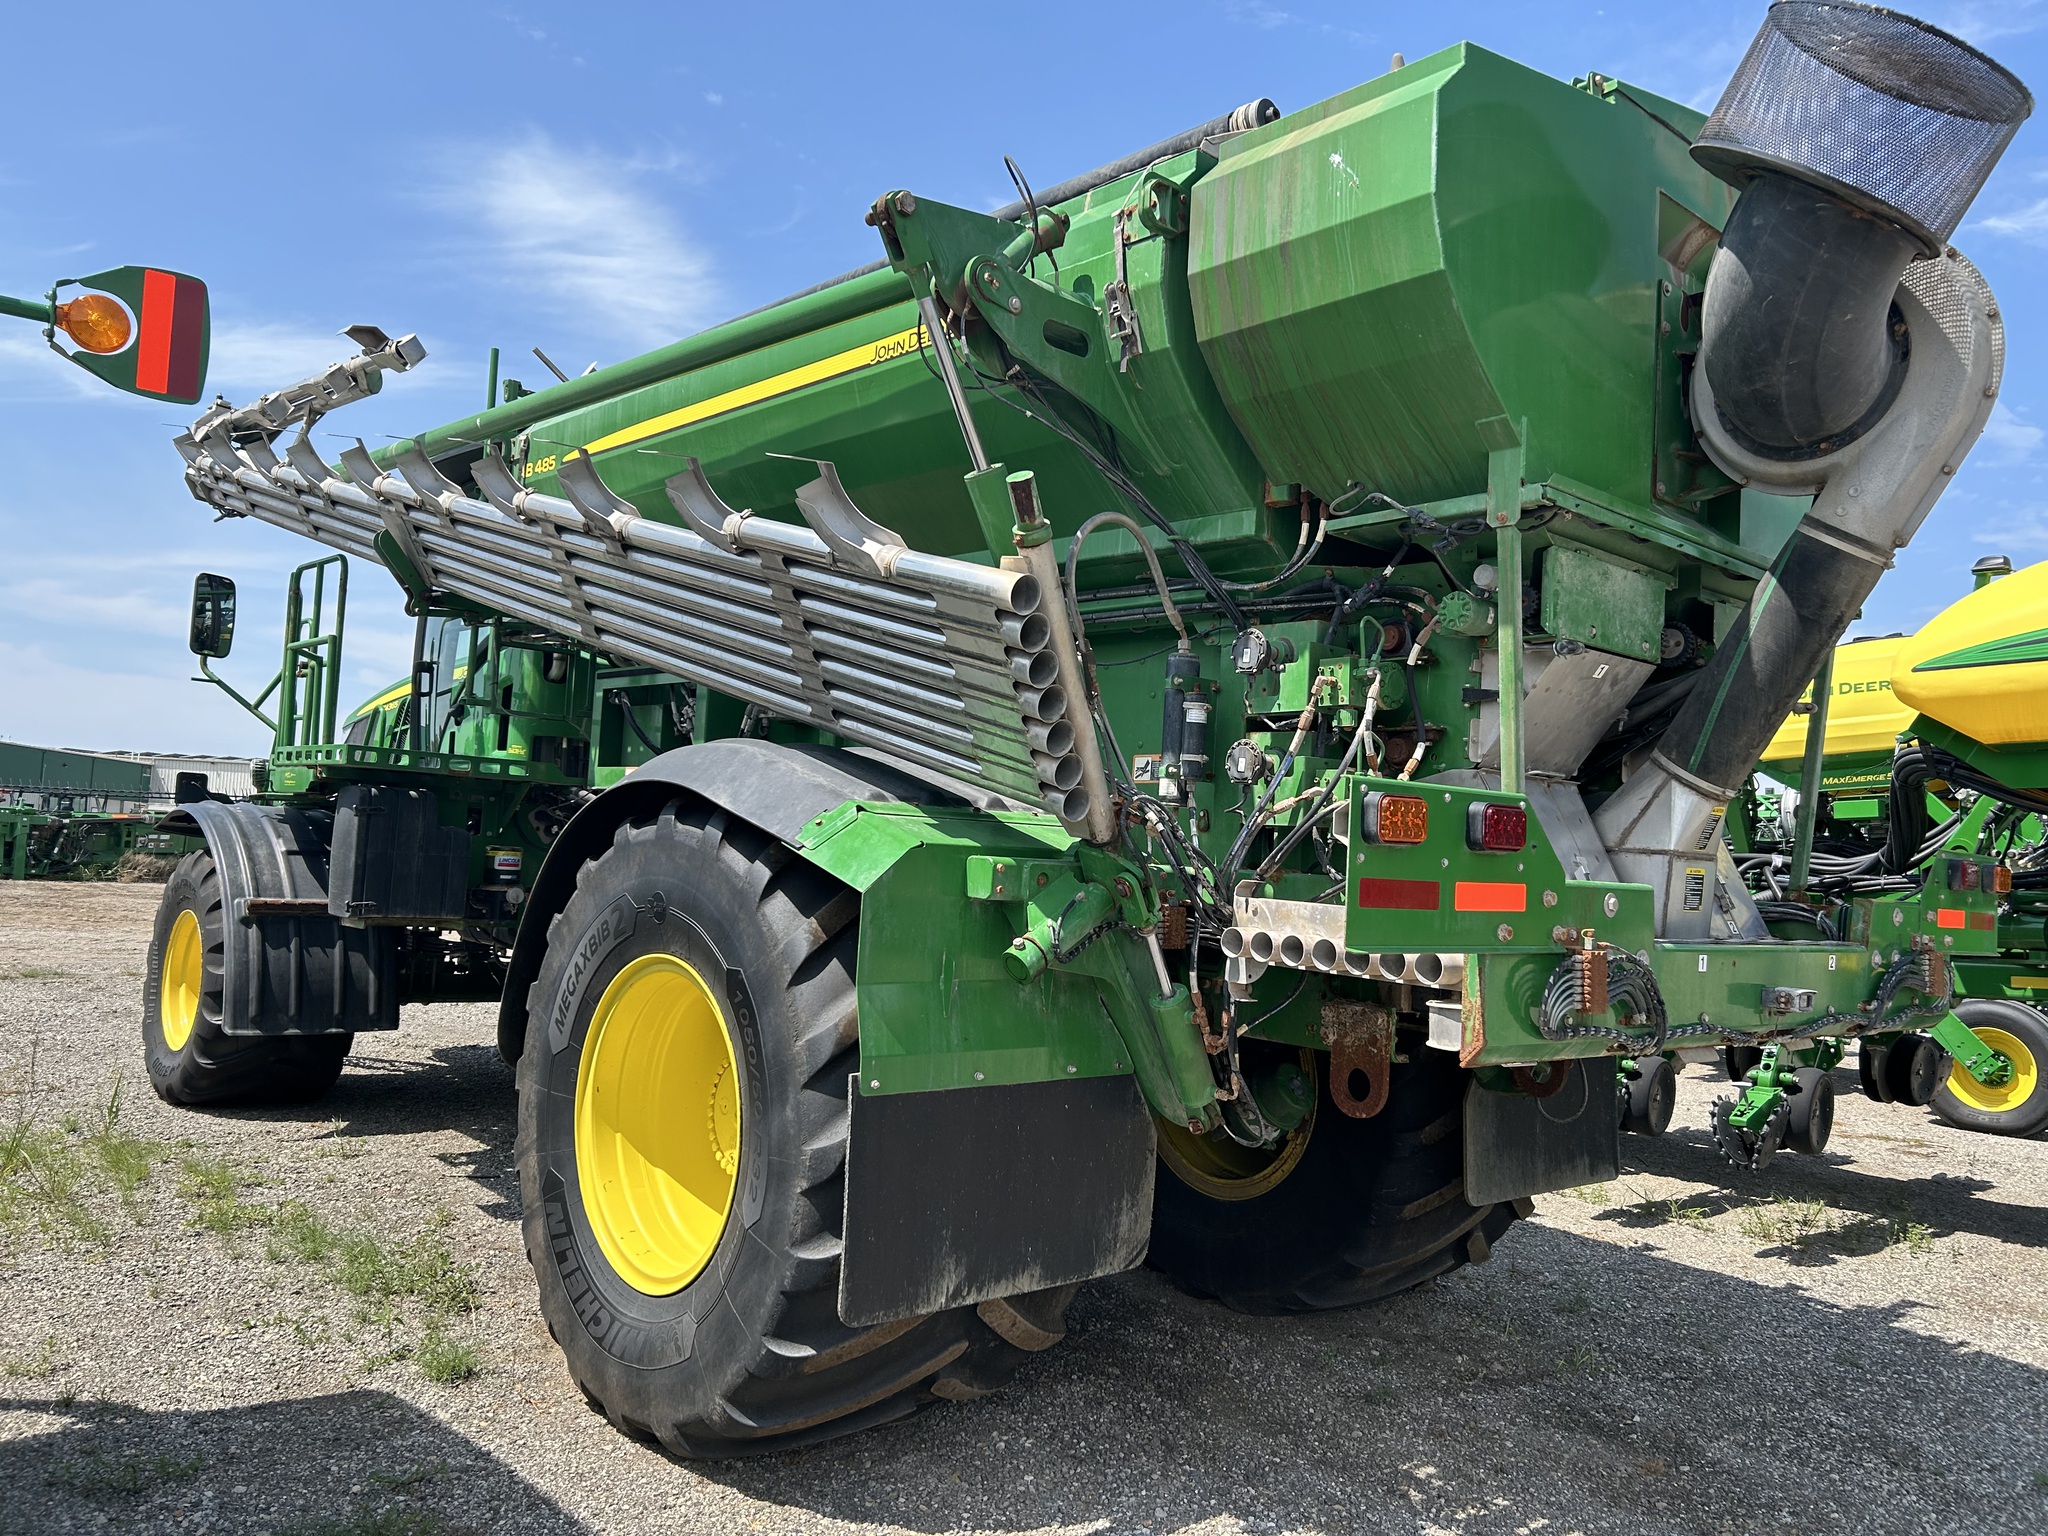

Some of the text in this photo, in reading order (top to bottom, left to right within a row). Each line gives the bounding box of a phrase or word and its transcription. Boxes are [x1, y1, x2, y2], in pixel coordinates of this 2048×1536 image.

[870, 330, 932, 363] JOHN DE
[534, 454, 557, 475] 485
[1838, 680, 1892, 695] DEER
[544, 1201, 649, 1362] MICHELIN
